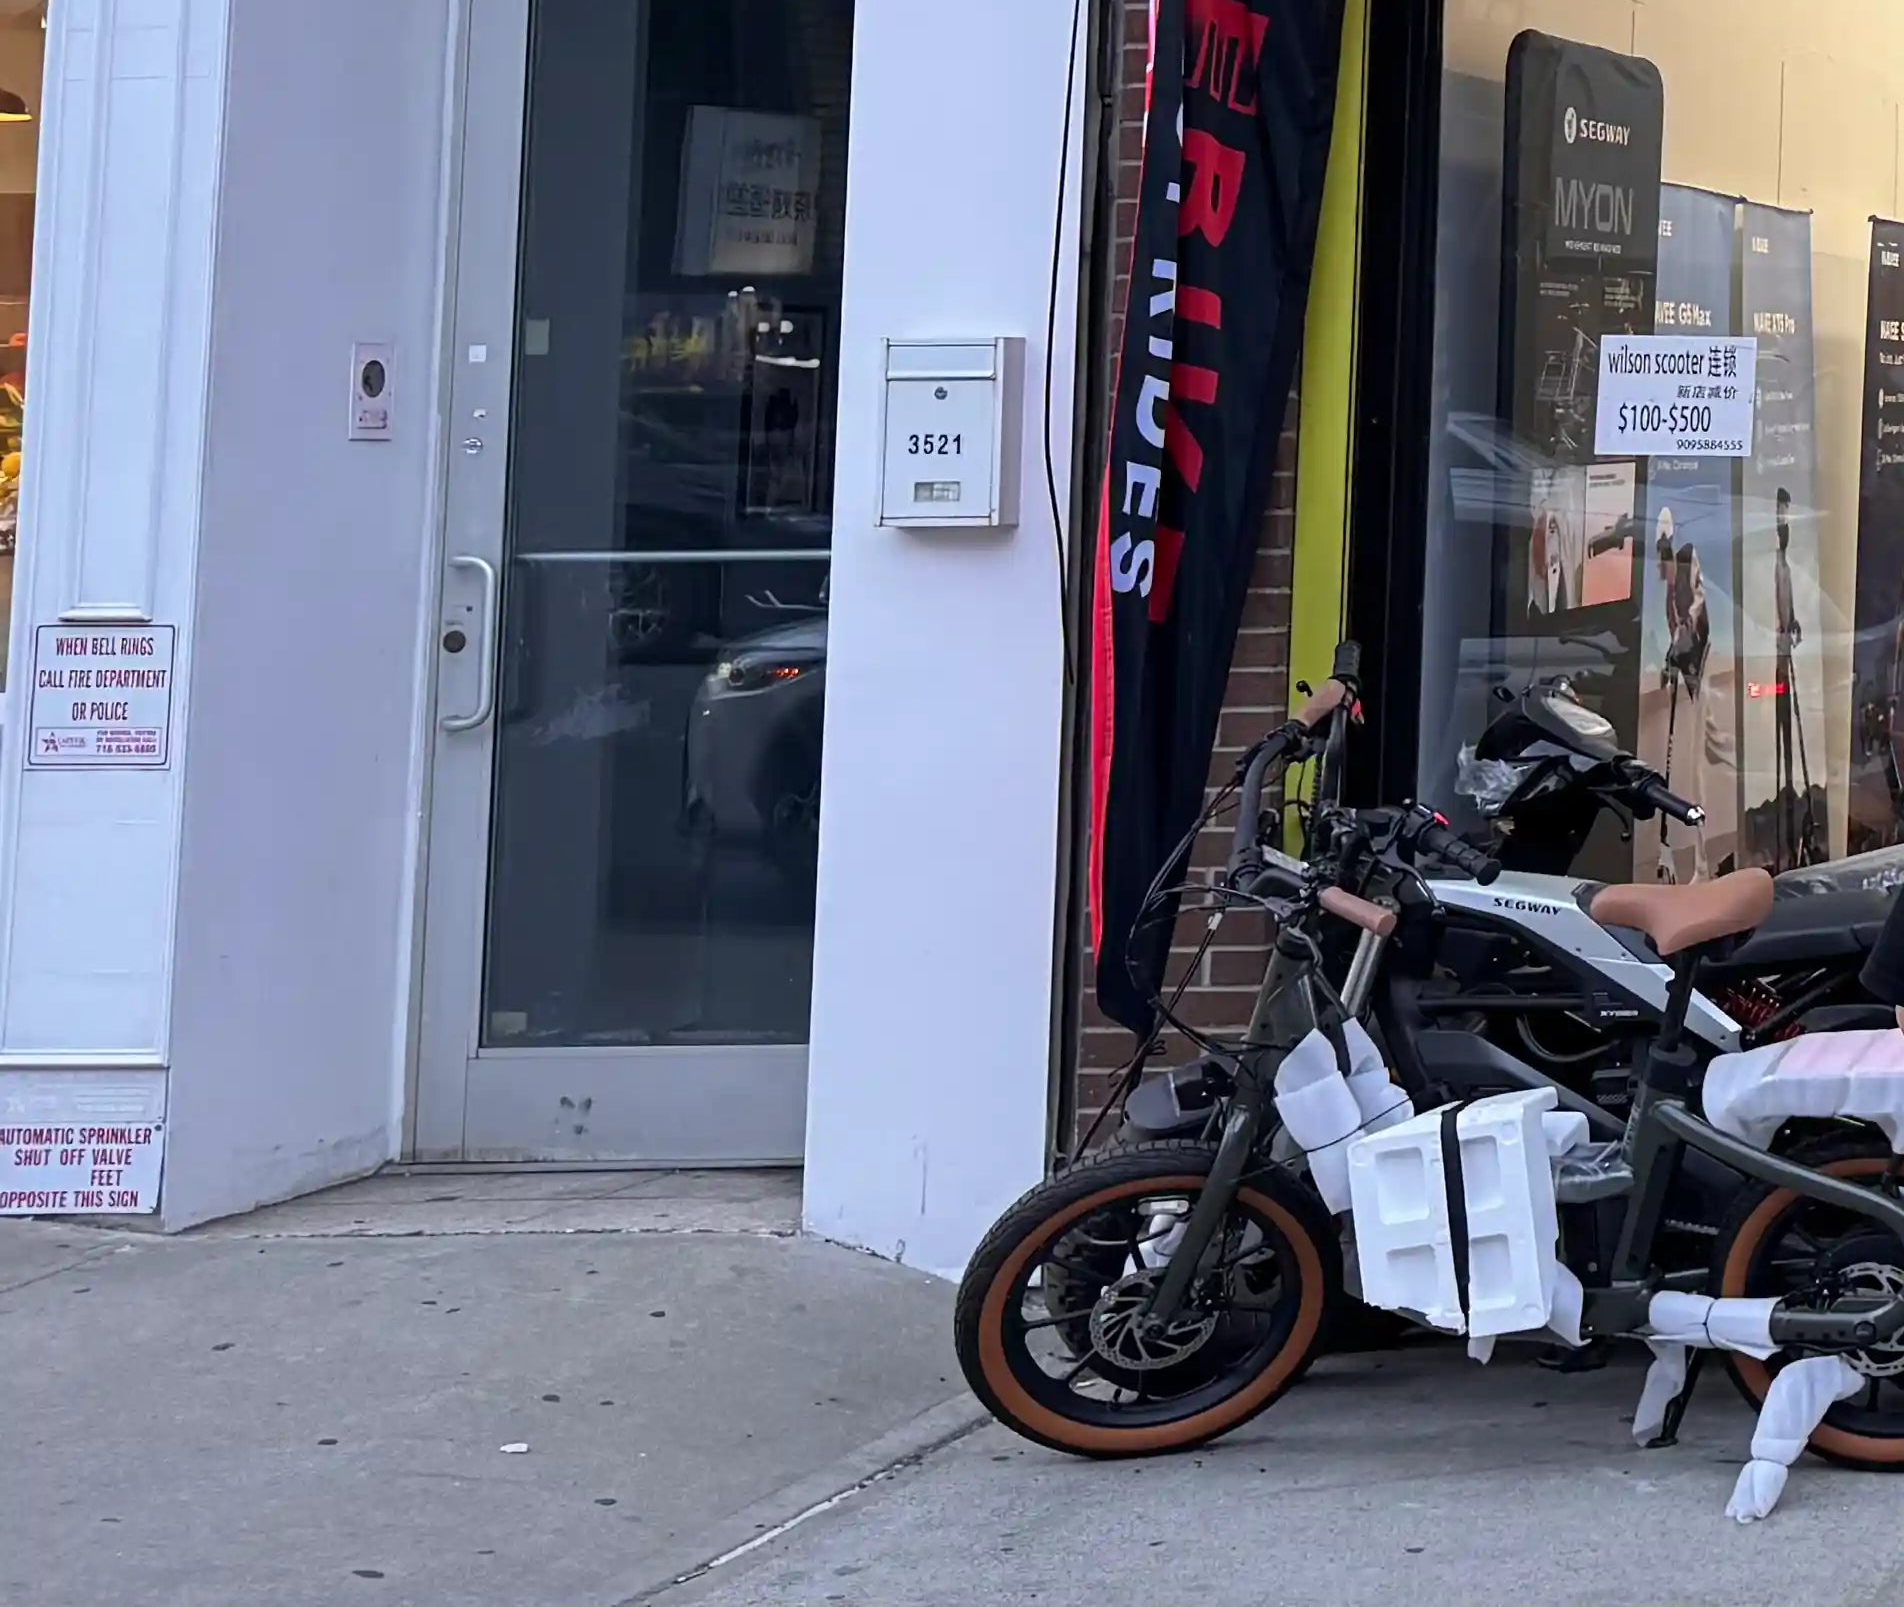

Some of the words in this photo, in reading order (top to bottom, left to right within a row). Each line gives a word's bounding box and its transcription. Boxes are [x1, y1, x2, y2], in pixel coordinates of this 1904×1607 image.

[1579, 118, 1631, 146] SEGWAY
[1554, 177, 1633, 235] MYON
[1608, 345, 1650, 375] wilson
[1655, 348, 1704, 375] scooter
[1618, 402, 1712, 434] $100-$500
[908, 434, 962, 455] 3521
[56, 637, 87, 656] WHEN
[91, 637, 117, 656] BELL
[121, 637, 155, 656] RINGS
[39, 669, 65, 689] CALL
[68, 669, 93, 689] FIRE
[95, 669, 167, 689] DEPARTMENT
[71, 701, 87, 721] OR
[90, 701, 129, 721] POLICE
[1494, 897, 1562, 916] SEGWAY
[0, 1127, 74, 1146] AUTOMATIC
[79, 1127, 153, 1146] SPRINKLER
[14, 1148, 52, 1167] SHUT
[60, 1148, 87, 1166] OFF
[92, 1148, 133, 1166] VALVE
[90, 1169, 123, 1187] FEET
[0, 1190, 68, 1209] OPPOSITE
[73, 1190, 104, 1208] THIS
[108, 1190, 139, 1208] SIGN
